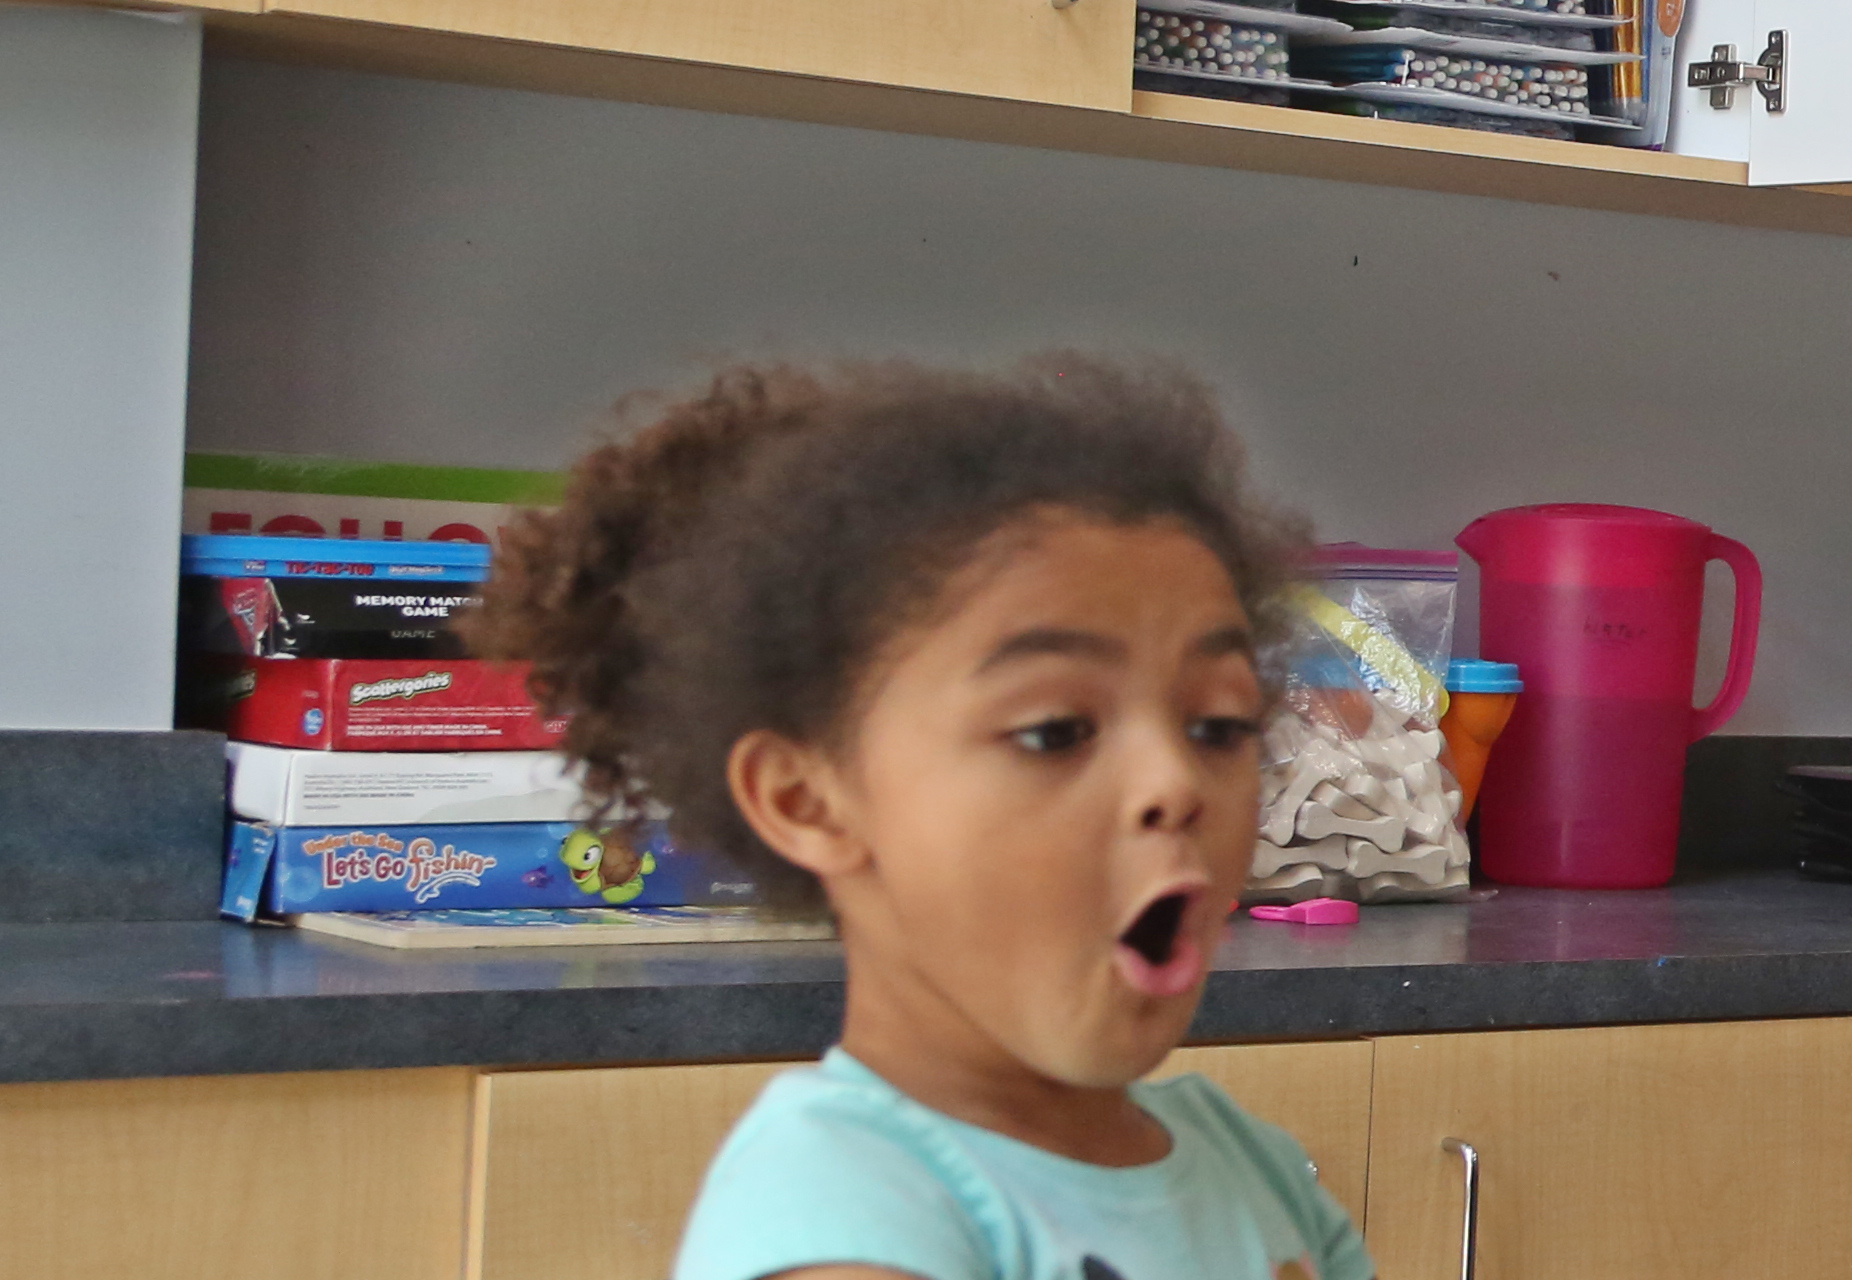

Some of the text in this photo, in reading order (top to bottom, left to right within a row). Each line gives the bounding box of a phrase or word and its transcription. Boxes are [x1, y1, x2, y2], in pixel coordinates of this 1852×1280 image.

[355, 595, 427, 608] MEMORY
[402, 606, 450, 618] GAME
[352, 673, 452, 705] Scattergories
[303, 831, 405, 855] Under the Sea
[322, 849, 372, 889] Let's
[373, 853, 406, 882] Go
